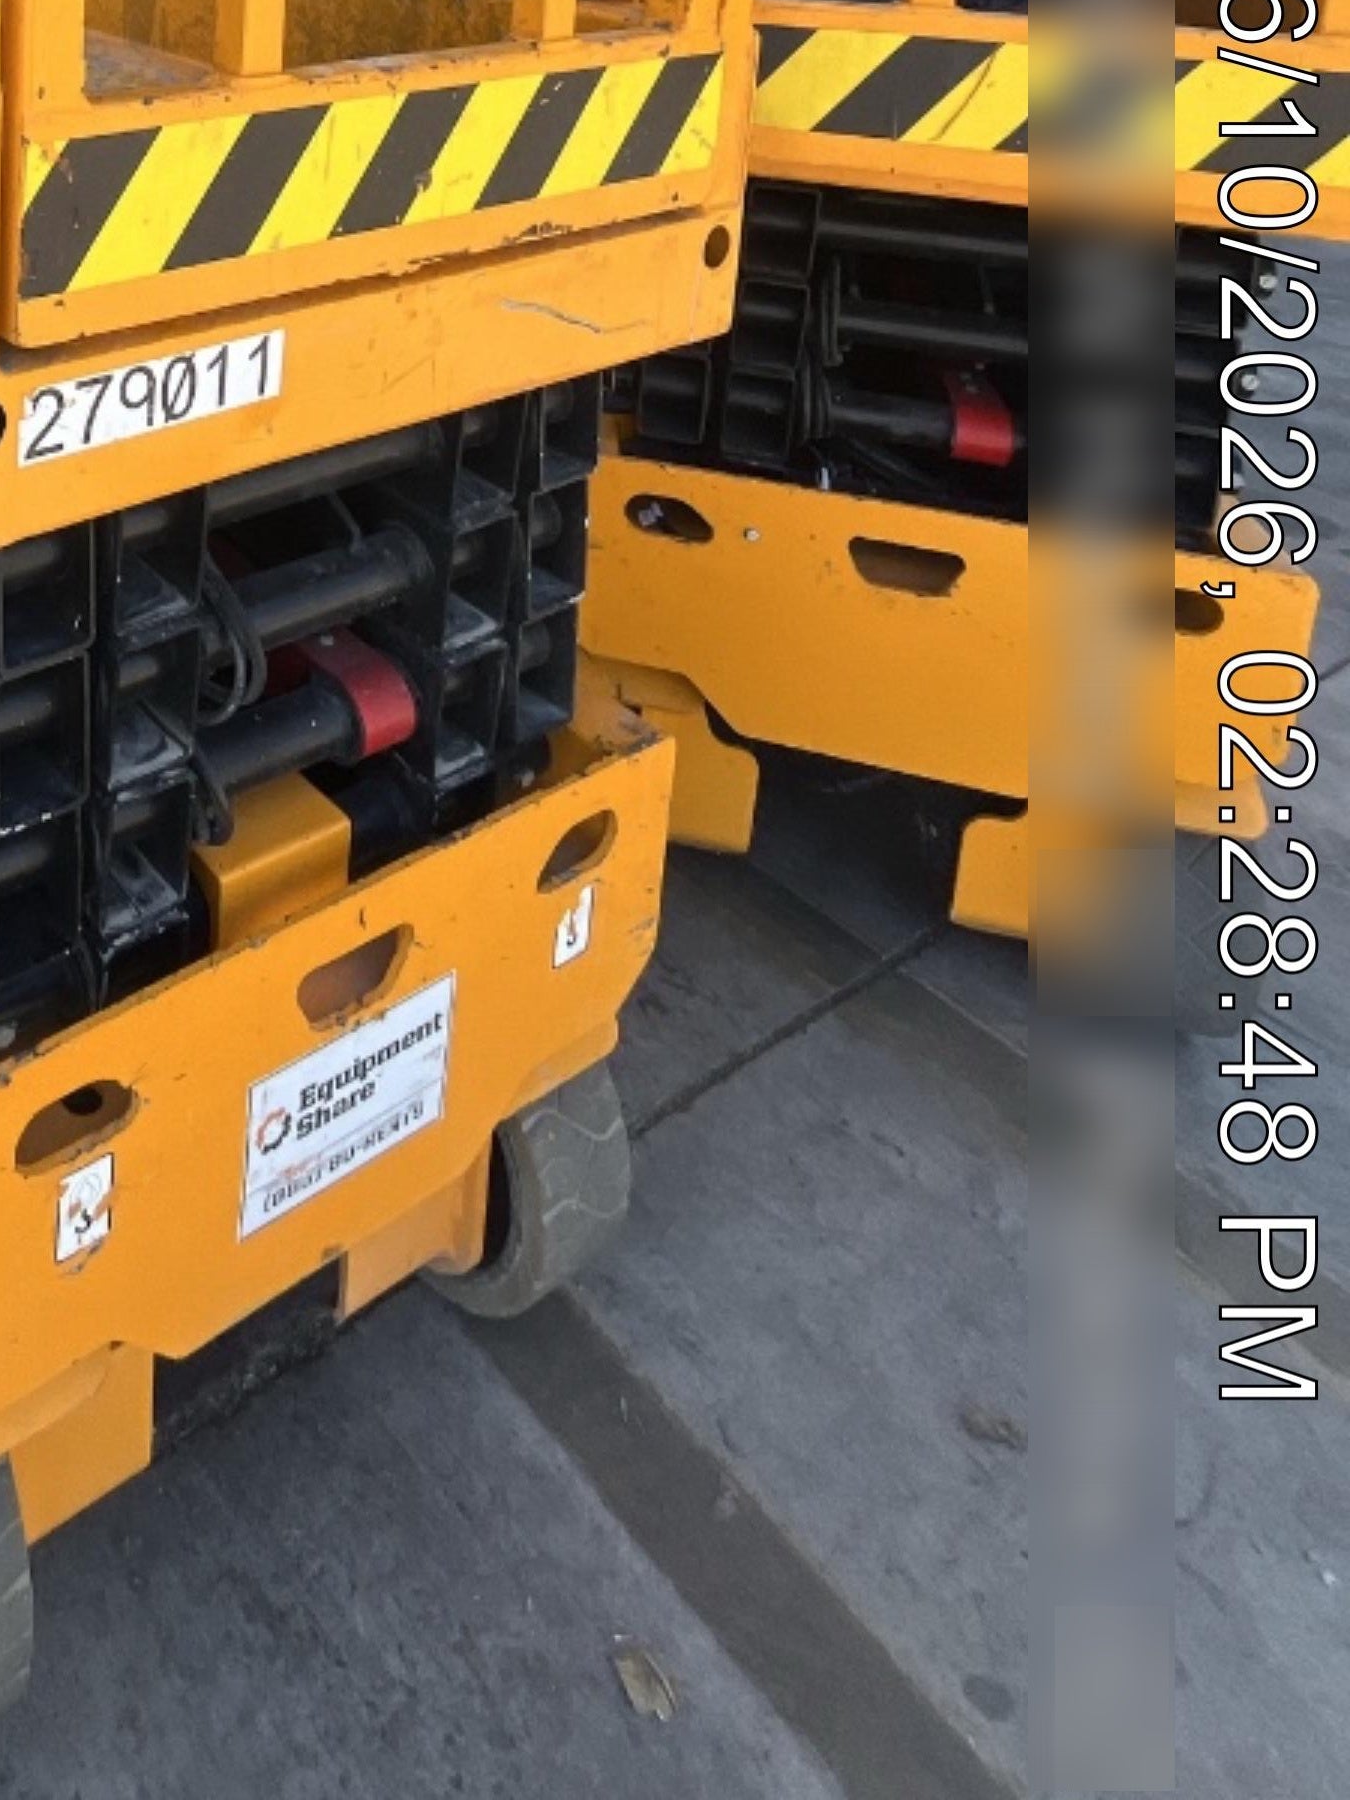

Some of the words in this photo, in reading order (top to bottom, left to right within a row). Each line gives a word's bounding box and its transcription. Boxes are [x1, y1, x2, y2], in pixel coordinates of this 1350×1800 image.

[24, 335, 270, 460] 279011
[296, 1080, 377, 1141] Share
[299, 1012, 443, 1112] Equipment
